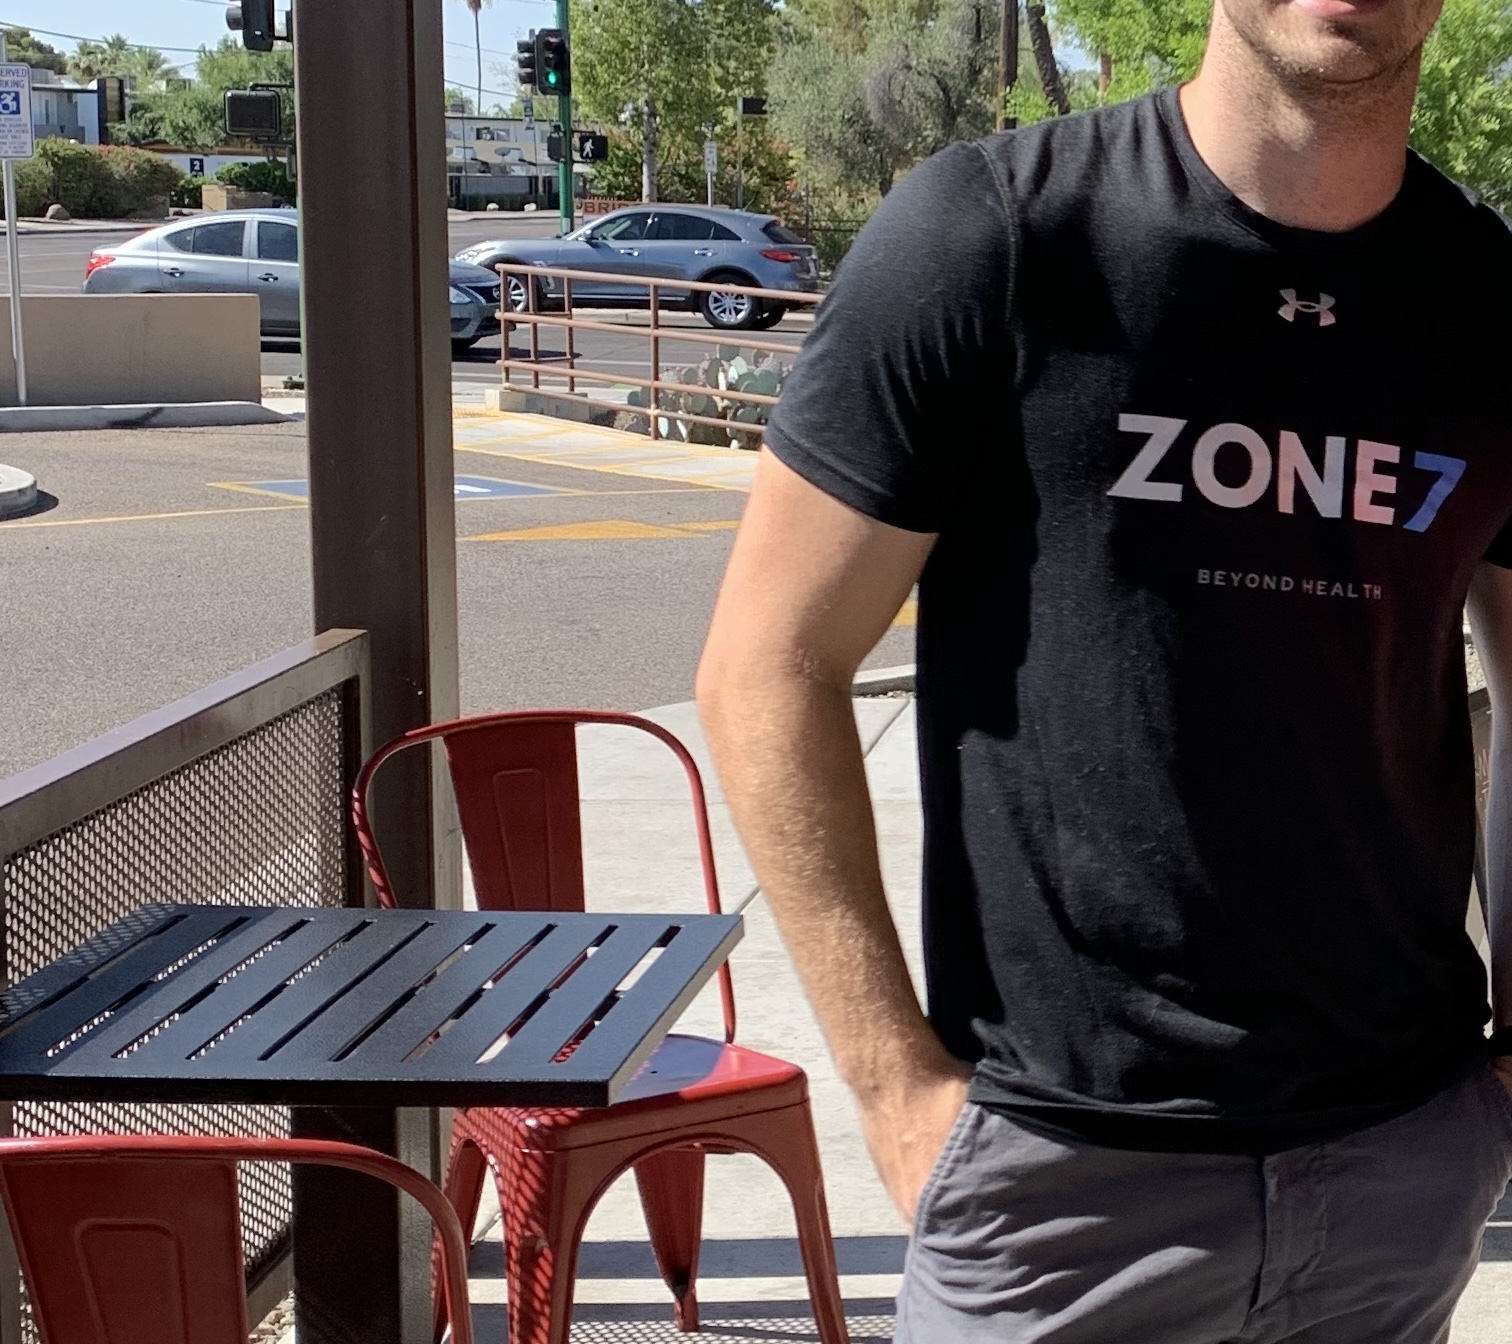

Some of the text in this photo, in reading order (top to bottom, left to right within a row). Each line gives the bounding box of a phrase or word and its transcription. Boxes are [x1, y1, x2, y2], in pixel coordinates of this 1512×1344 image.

[0, 68, 27, 77] ERVED
[193, 160, 201, 171] 2
[1197, 568, 1382, 600] BEYOND HEALTH
